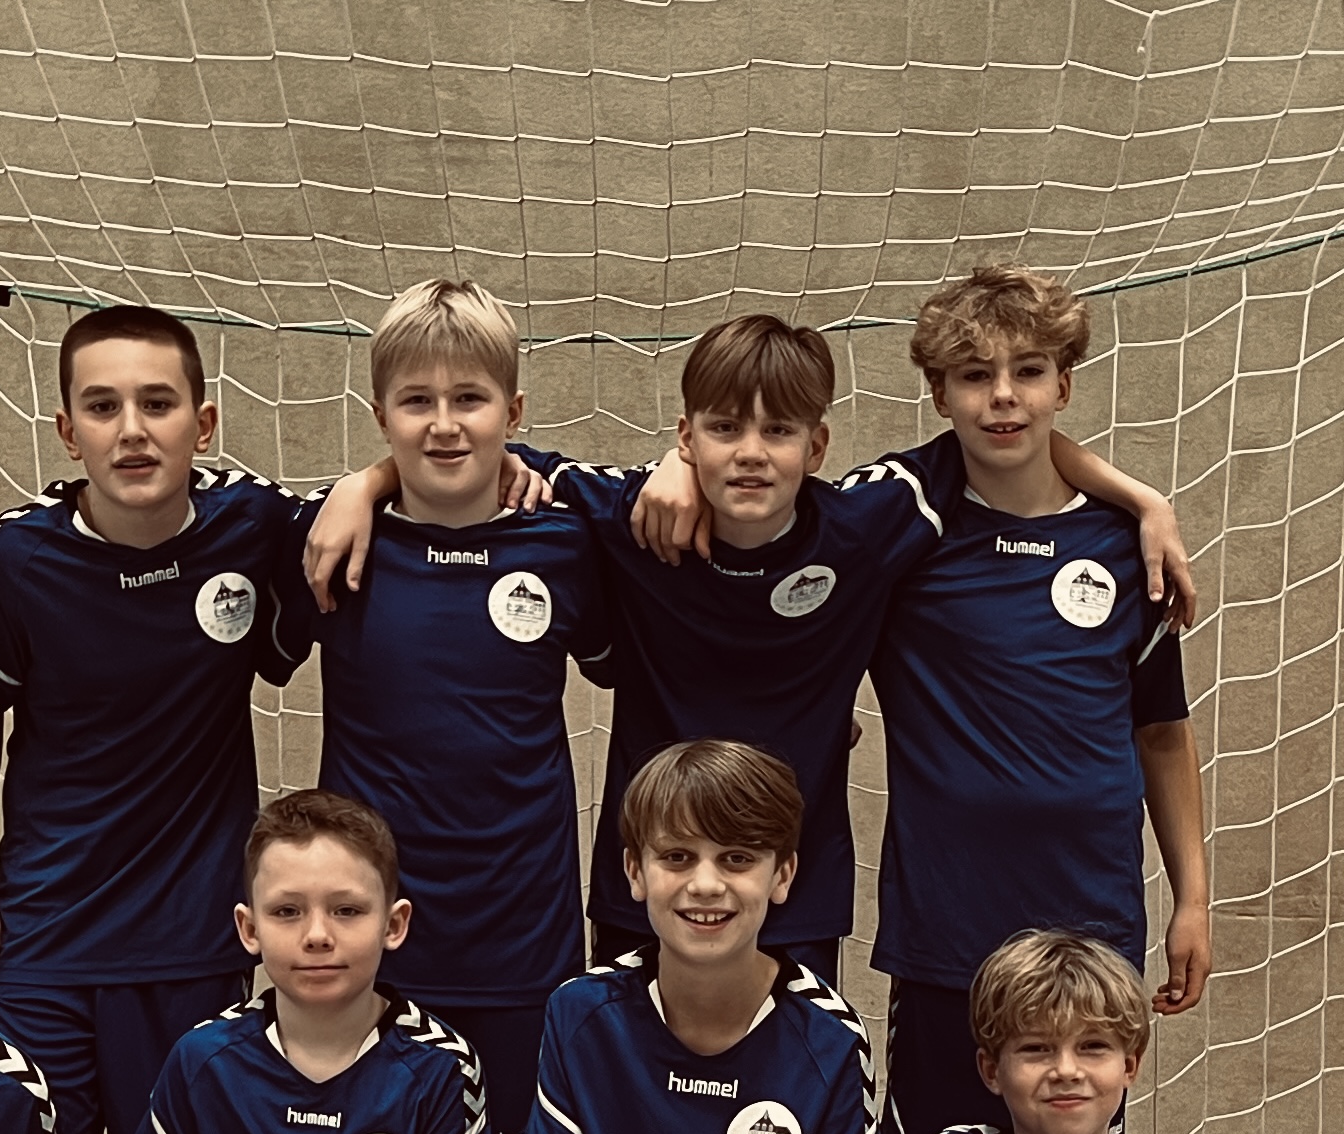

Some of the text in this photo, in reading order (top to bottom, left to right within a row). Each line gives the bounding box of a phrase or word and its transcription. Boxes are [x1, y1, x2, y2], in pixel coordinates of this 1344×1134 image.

[427, 545, 489, 566] hummel
[995, 535, 1055, 558] hummel
[119, 560, 180, 589] hummel
[668, 1070, 739, 1099] hummel
[286, 1106, 342, 1129] hummel
